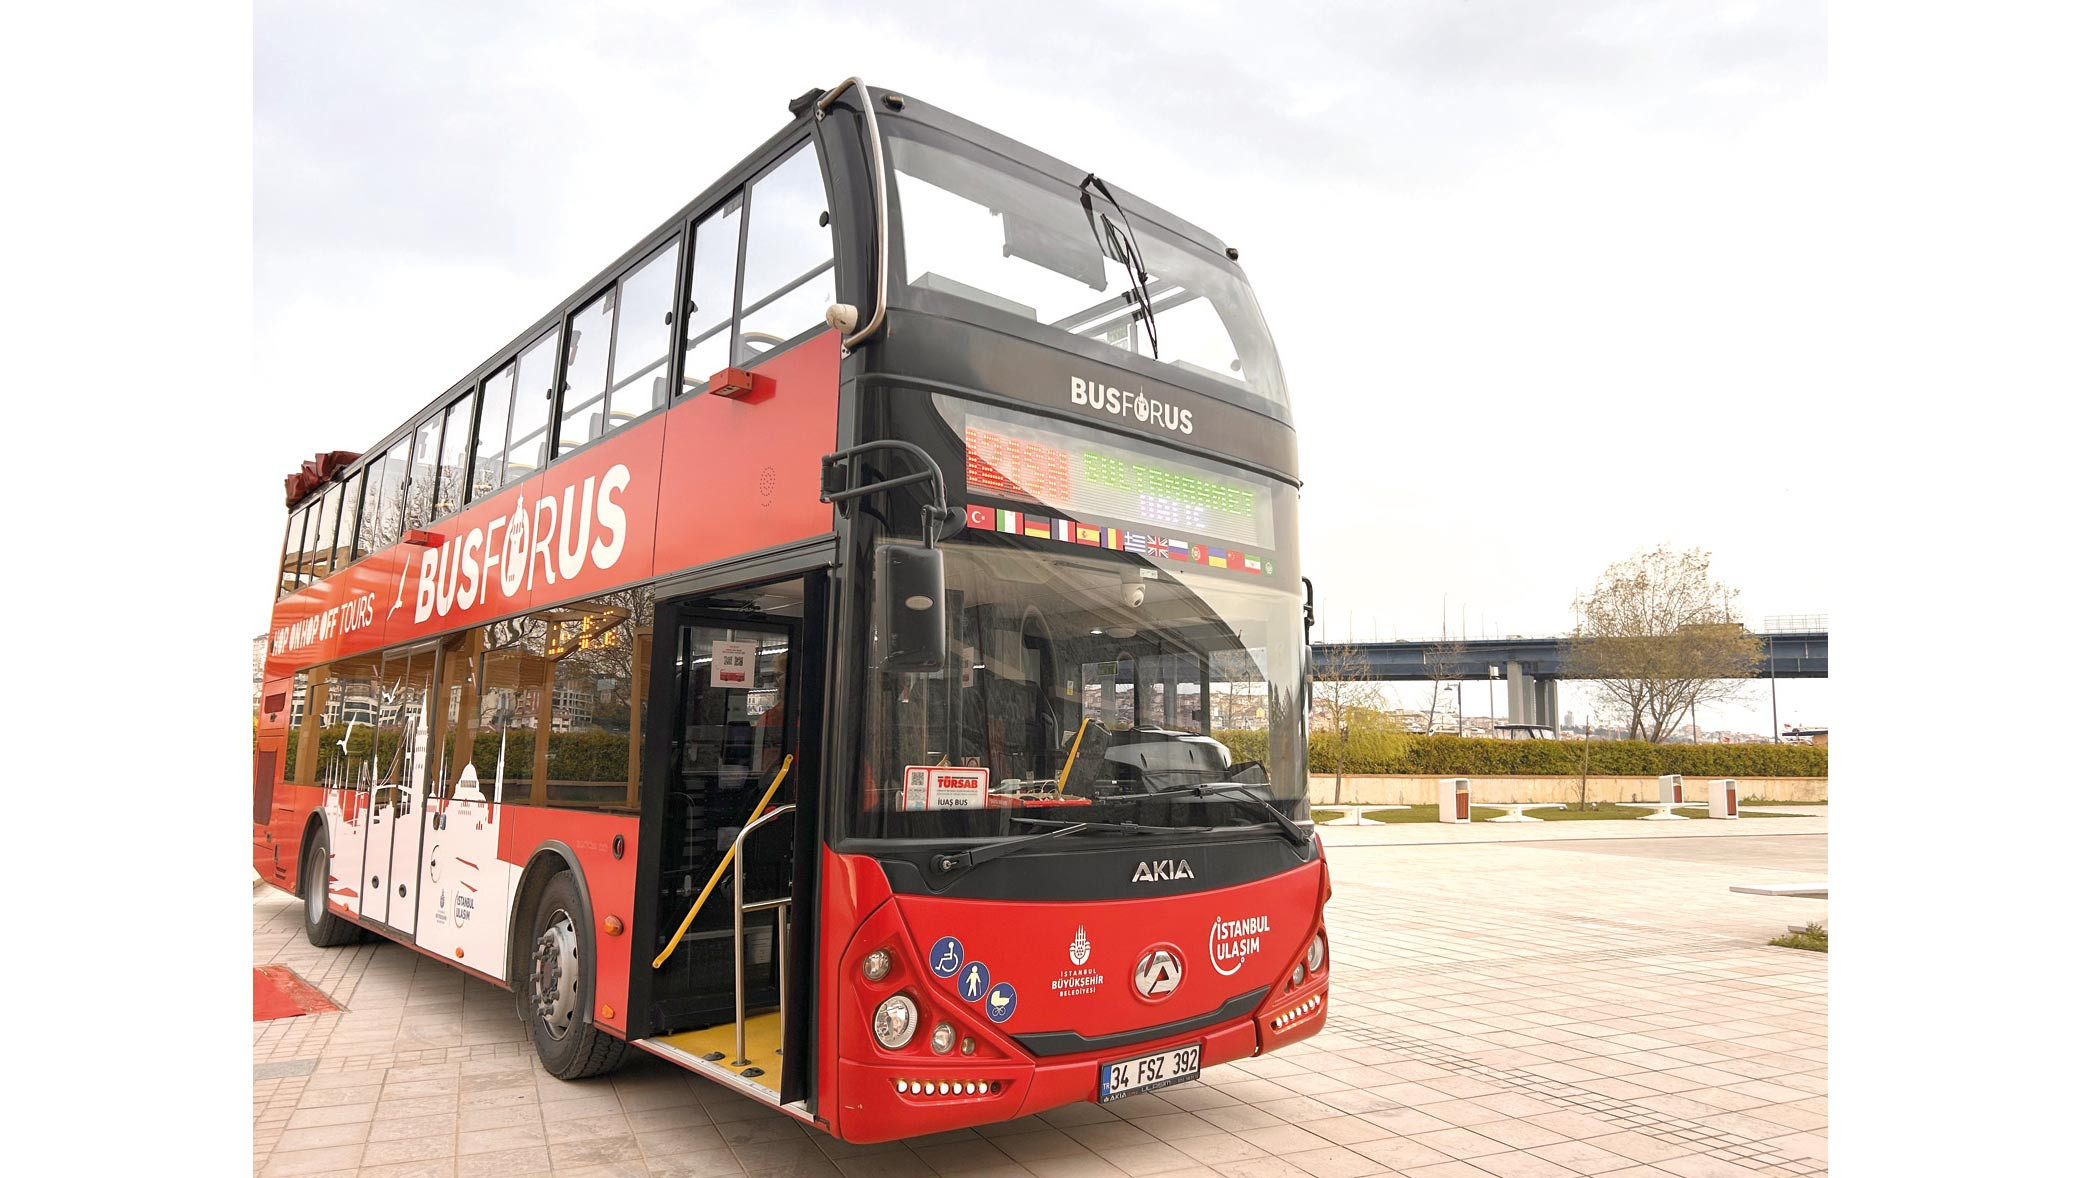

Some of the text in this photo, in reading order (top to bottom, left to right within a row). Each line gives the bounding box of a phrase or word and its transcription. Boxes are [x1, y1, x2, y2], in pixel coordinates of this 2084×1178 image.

[1071, 376, 1193, 435] BUSFORUS
[414, 464, 631, 624] BUSFORUS
[272, 592, 375, 657] HOP ON HOP OFF TOURS
[937, 775, 978, 789] TÜRSAB
[1131, 859, 1195, 883] AKIA
[1051, 974, 1104, 990] BÜYÜKŞEHİR
[1059, 986, 1097, 998] BELEDİYESİ
[1111, 1064, 1130, 1091] 34
[1137, 1056, 1165, 1084] FSZ
[1172, 1048, 1198, 1076] 392
[1102, 1082, 1111, 1091] TR
